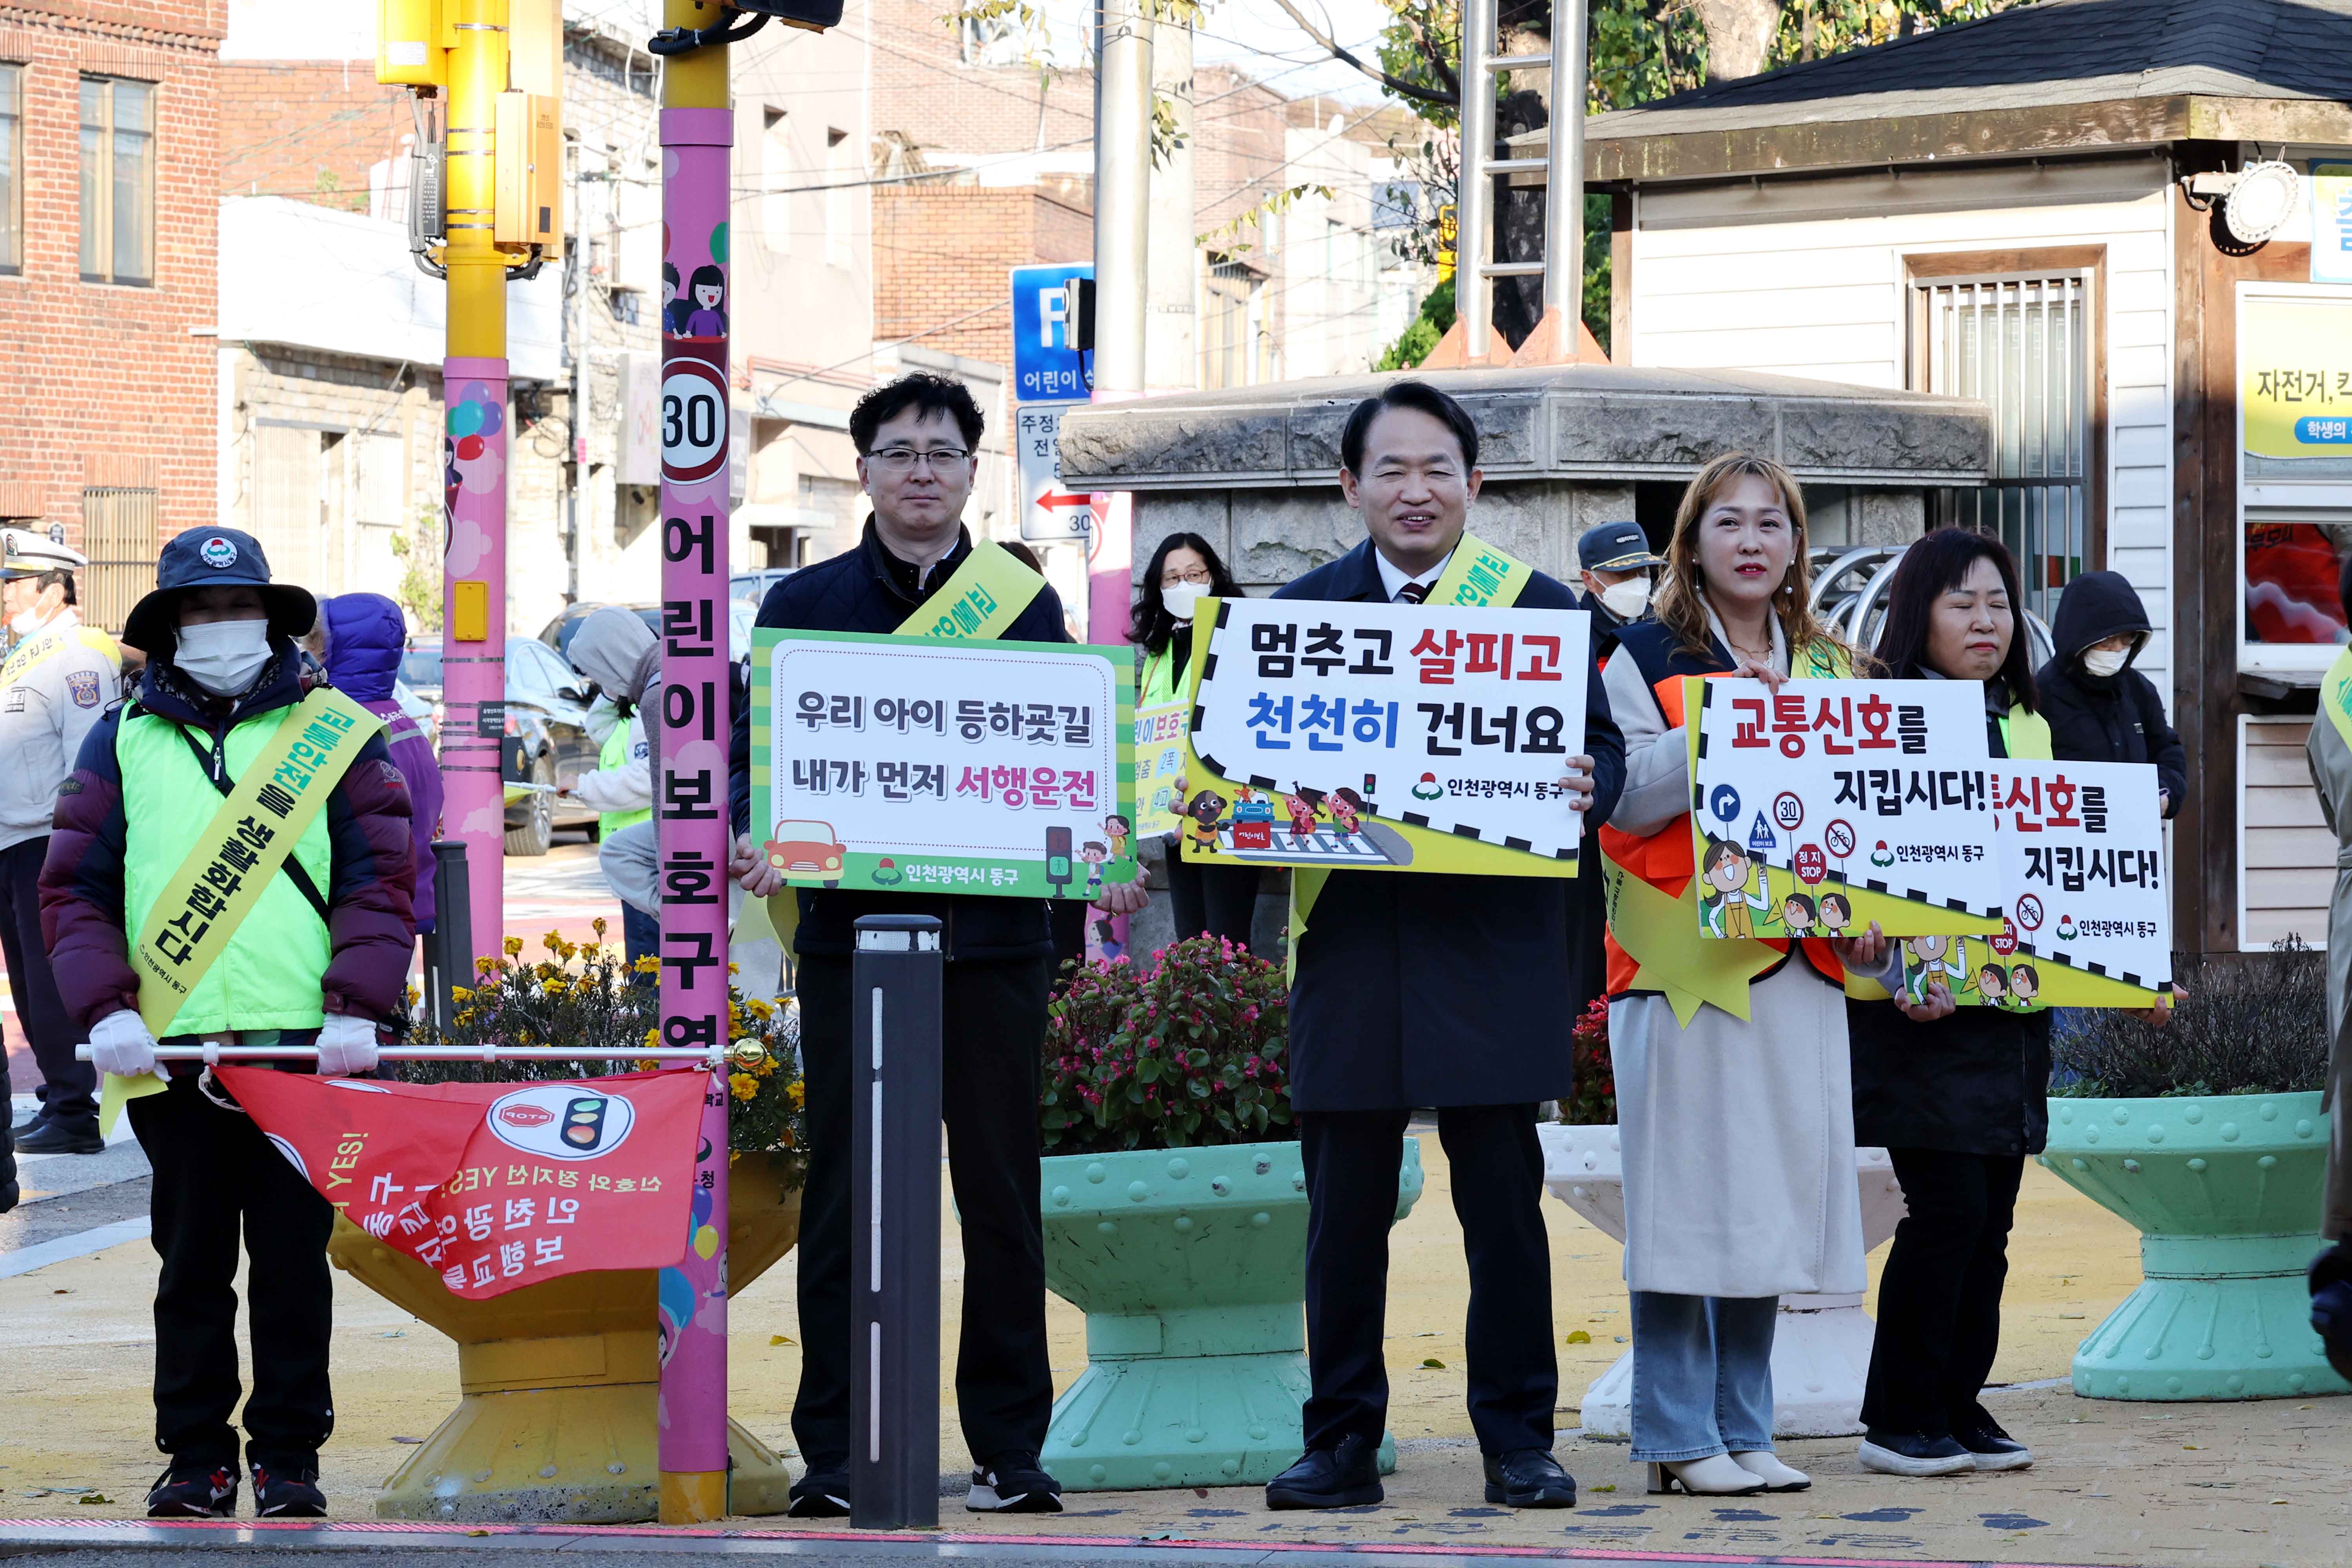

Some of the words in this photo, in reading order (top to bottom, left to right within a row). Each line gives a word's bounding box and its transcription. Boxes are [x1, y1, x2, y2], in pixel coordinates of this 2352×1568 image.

[1024, 370, 1077, 393] 어린이
[662, 394, 715, 448] 30
[1021, 414, 1060, 434] 주정
[2308, 421, 2346, 439] 학생의
[1252, 622, 1394, 678] 멈추고
[1410, 629, 1562, 684] 살피고
[796, 691, 862, 728] 우리
[874, 699, 944, 732] 아이
[956, 700, 1091, 744] 등하굣길
[1246, 692, 1399, 752] 천천히
[1417, 702, 1566, 755] 건너요
[1732, 693, 1928, 759] 교통신호를
[793, 759, 866, 793] 내가
[877, 761, 944, 799] 먼저
[956, 766, 1094, 808] 서행운전
[1448, 778, 1529, 799] 인천광역시
[1534, 782, 1564, 800] 동구
[1834, 769, 1986, 816] 지킵시다!
[1991, 774, 2108, 833] 신호를
[1781, 801, 1796, 817] 30
[906, 864, 985, 885] 인천광역시
[989, 868, 1019, 886] 동구
[1801, 866, 1821, 877] STOP
[1896, 845, 1958, 863] 인천광역시
[1962, 846, 1985, 861] 동구
[2024, 847, 2159, 892] 지킵시다!
[154, 815, 275, 966] 생활화합시다
[1995, 938, 2013, 949] STOP
[2004, 924, 2013, 936] 지
[2079, 920, 2134, 937] 인천광역시
[2137, 922, 2157, 936] 동구
[143, 951, 172, 986] 인천광역시
[172, 982, 187, 995] 동구
[326, 1132, 369, 1190] YES!
